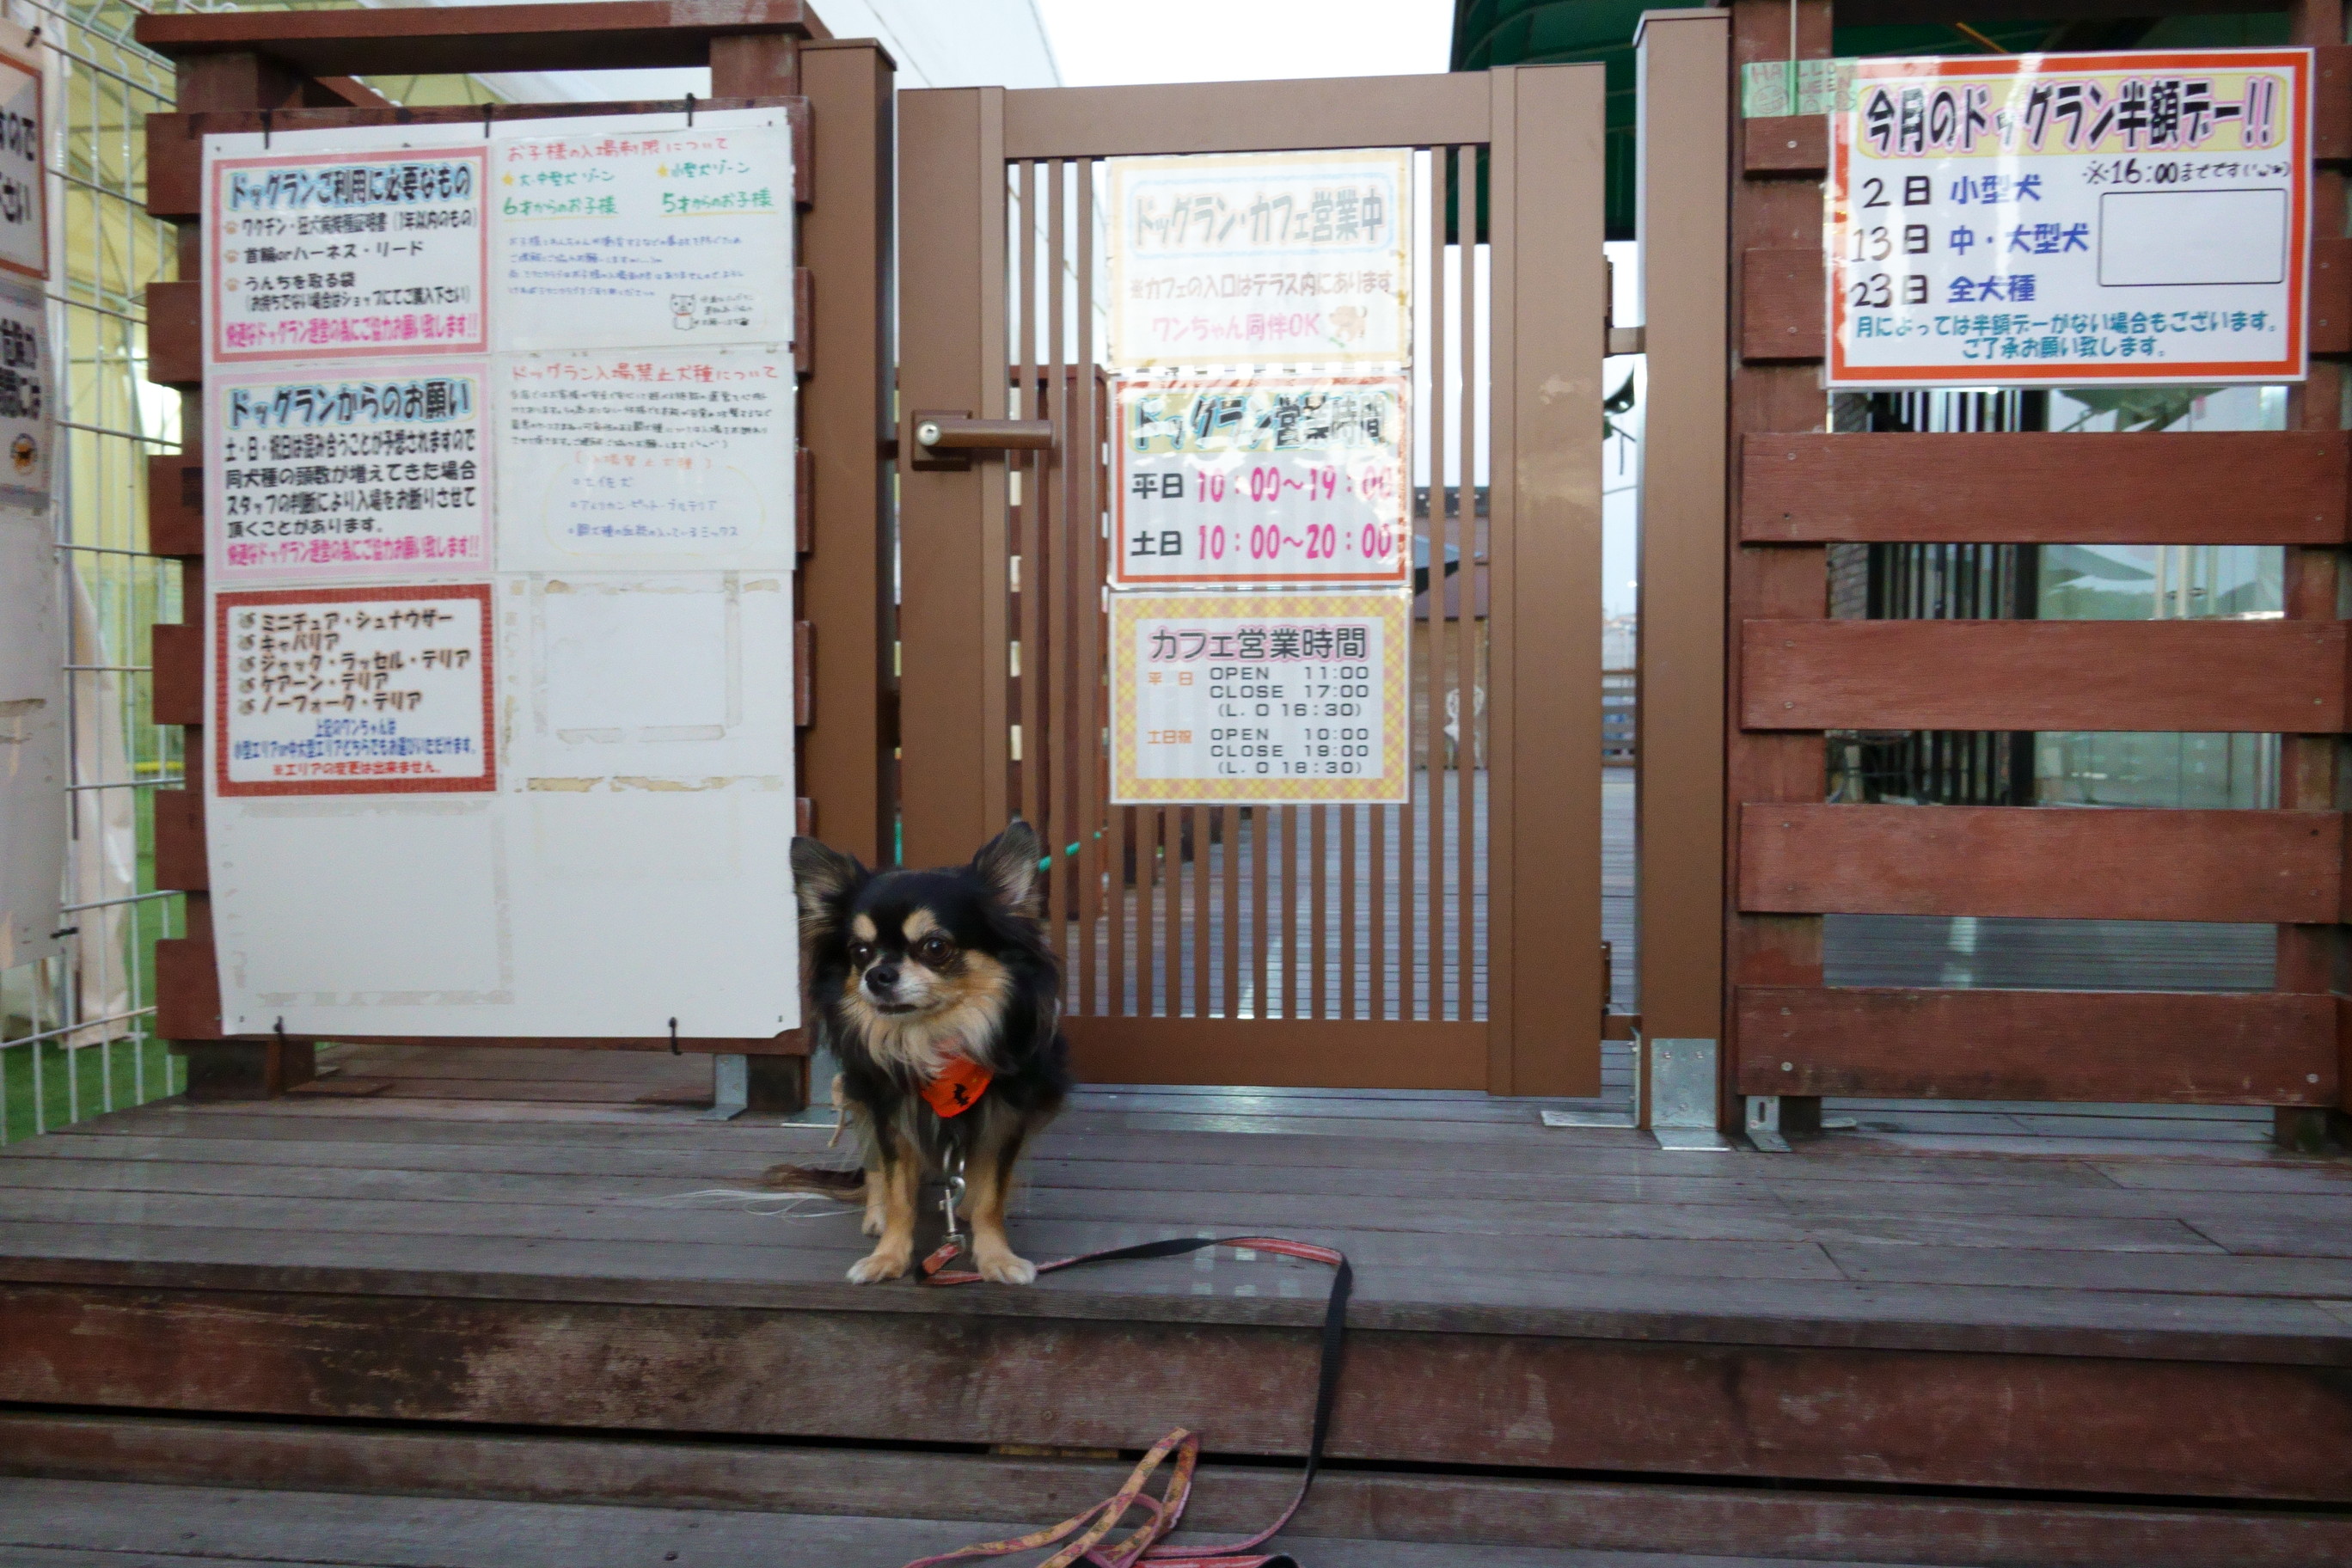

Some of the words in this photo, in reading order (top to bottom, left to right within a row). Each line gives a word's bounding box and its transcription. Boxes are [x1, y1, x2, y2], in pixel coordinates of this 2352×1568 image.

[230, 166, 472, 209] ドッグランご利用に必要なもの
[1949, 174, 2042, 205] 小型犬
[503, 196, 619, 215] 6才からのお子様
[661, 187, 774, 213] 5才からのお子様
[1136, 187, 1383, 247] ドッグラン・カフェ営業中
[1949, 222, 2090, 254] 中・大型犬
[245, 272, 356, 291] うんちを取る袋
[1130, 272, 1393, 300] ※カフェの入口はテラス内にあります
[1947, 274, 2037, 304] 全犬種
[1152, 313, 1320, 342] ワンちゃん同伴OK
[1855, 310, 2276, 337] 月によっては半額デーがない場合もございます。
[1962, 335, 2166, 359] ご了承お願い致します。
[511, 362, 779, 383] ドッグラン入場禁止犬種について
[230, 381, 471, 428] ドッグランからのお願い
[225, 459, 477, 489] 同犬種の頭数が増えてきた場合
[1130, 473, 1184, 500] 平日
[227, 518, 384, 539] 頂くことがあります。
[1130, 530, 1183, 556] 土日
[261, 609, 453, 632] ミニチュア・シュナウザー
[260, 633, 340, 652] キャバリア
[1151, 628, 1367, 660] カフェ営業時間
[260, 649, 471, 672] ジャック・ラッセル・テリア
[261, 671, 389, 693] ケアーン・テリア
[1210, 666, 1271, 681] OPEN
[1304, 666, 1369, 680] 11:00
[261, 691, 422, 714] ノーフォーク・テリア
[1210, 685, 1284, 699] CLOSE
[1304, 684, 1369, 698] 17:00
[1148, 730, 1192, 744] 土日祝
[1210, 728, 1270, 742] OPEN
[1304, 728, 1369, 741] 10:00
[1210, 744, 1284, 758] CLOSE
[1304, 744, 1369, 758] 19:00
